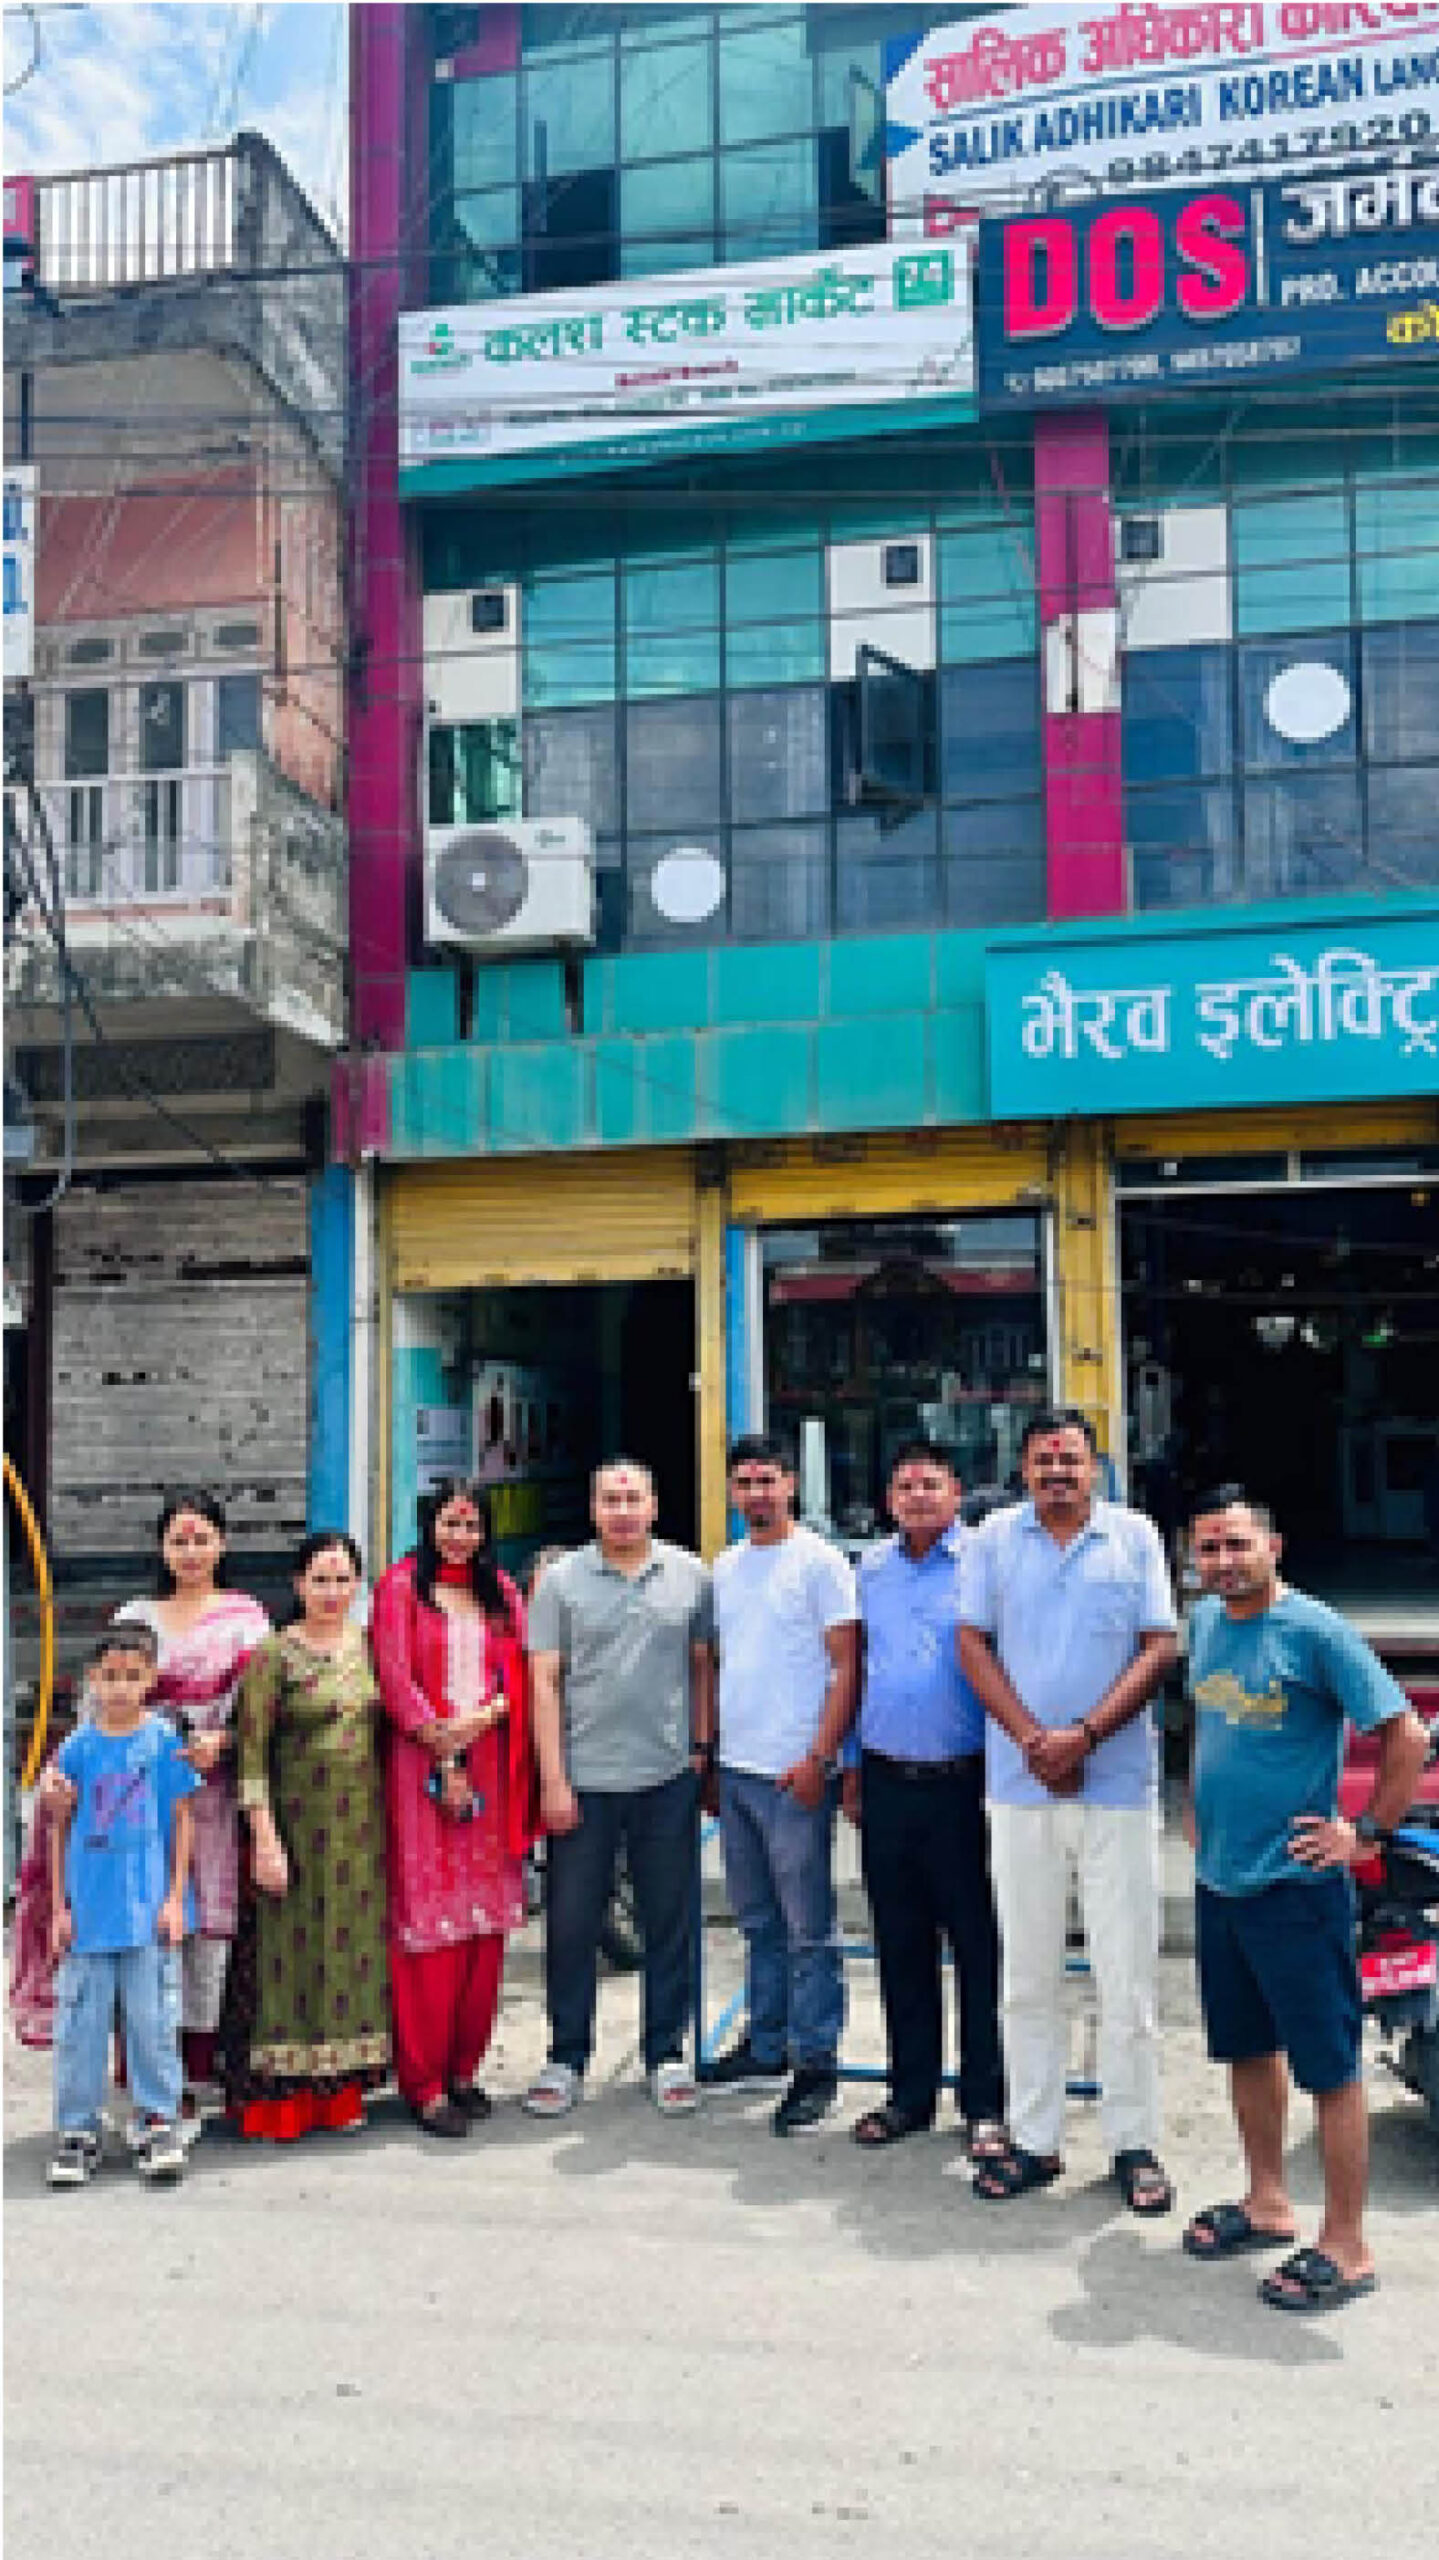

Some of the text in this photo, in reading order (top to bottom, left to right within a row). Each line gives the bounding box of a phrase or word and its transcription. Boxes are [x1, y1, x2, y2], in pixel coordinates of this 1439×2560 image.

[924, 27, 1066, 110] सालिक
[929, 120, 1023, 176] SALIK
[1033, 83, 1202, 152] ADHIKARI
[1219, 57, 1363, 120] KOREAN
[1003, 194, 1251, 337] DOS
[1281, 272, 1348, 307] PRO.
[484, 312, 604, 363] कलश
[1021, 966, 1171, 1058] भैरव
